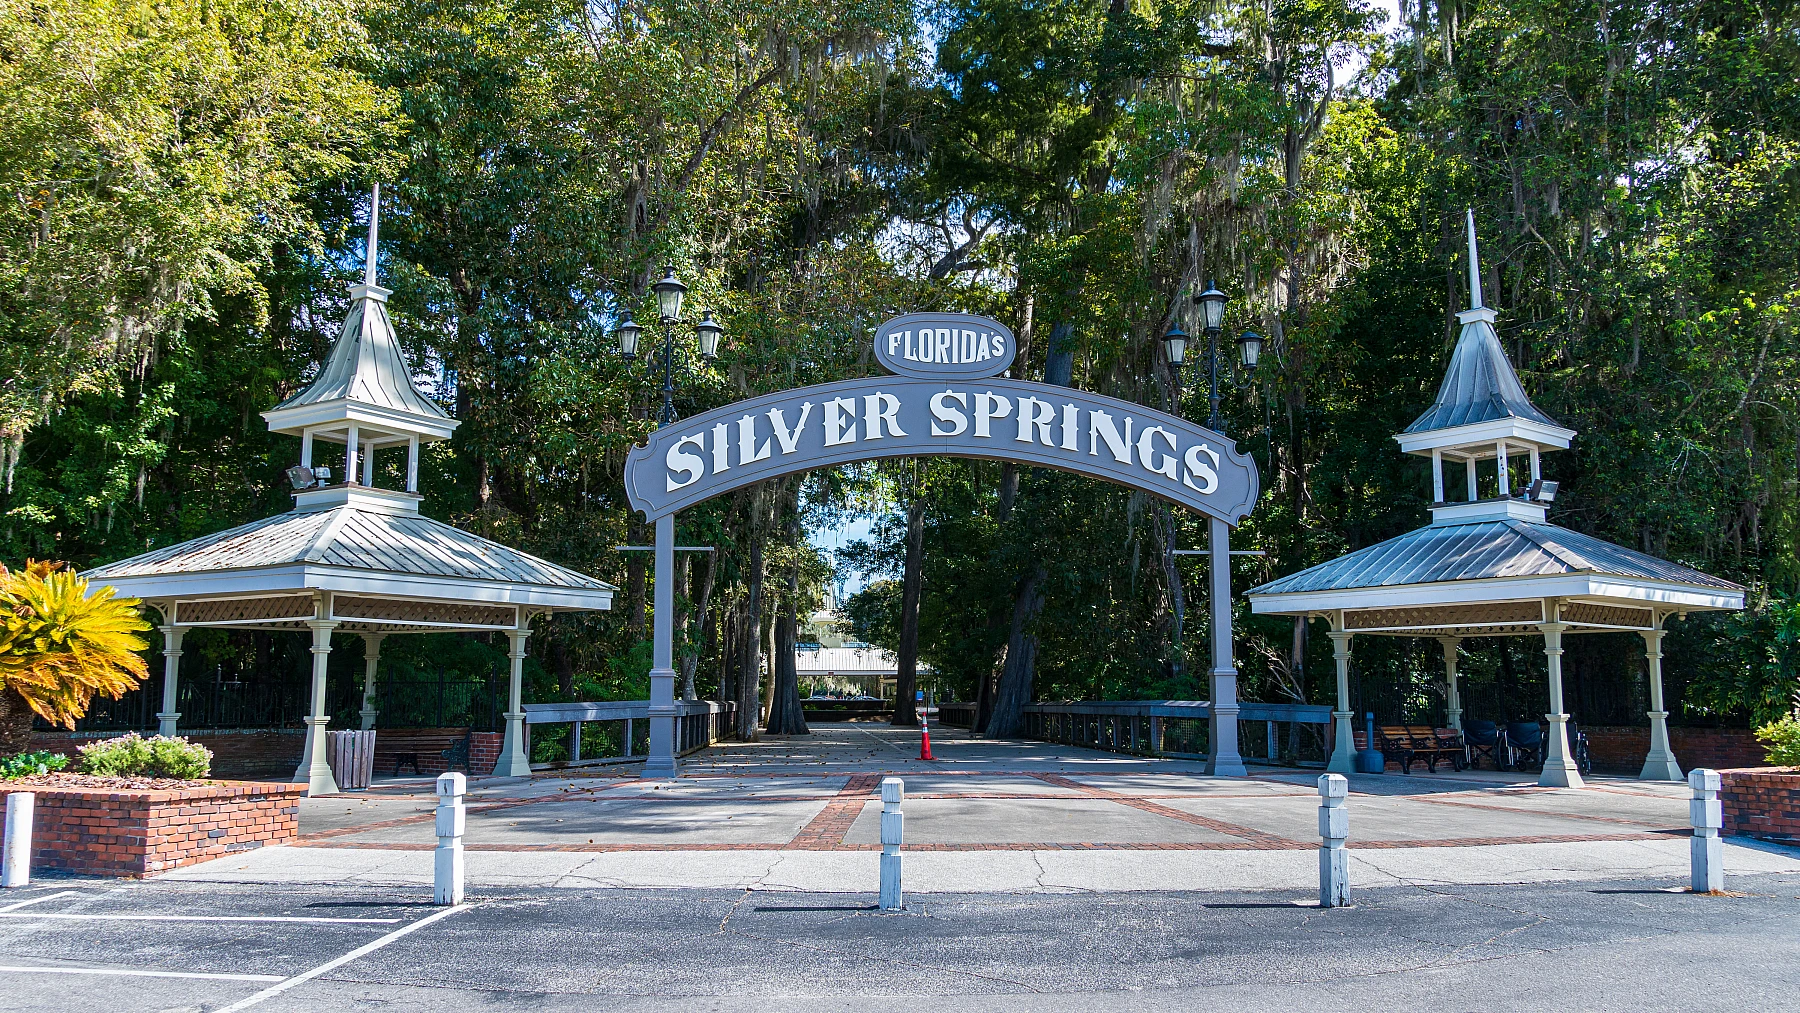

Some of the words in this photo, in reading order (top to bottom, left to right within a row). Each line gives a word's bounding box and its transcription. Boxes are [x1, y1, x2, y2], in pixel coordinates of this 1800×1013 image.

[887, 328, 1005, 364] FLORIDA'S
[666, 391, 909, 493] SILVER
[929, 390, 1220, 495] SPRINGS
